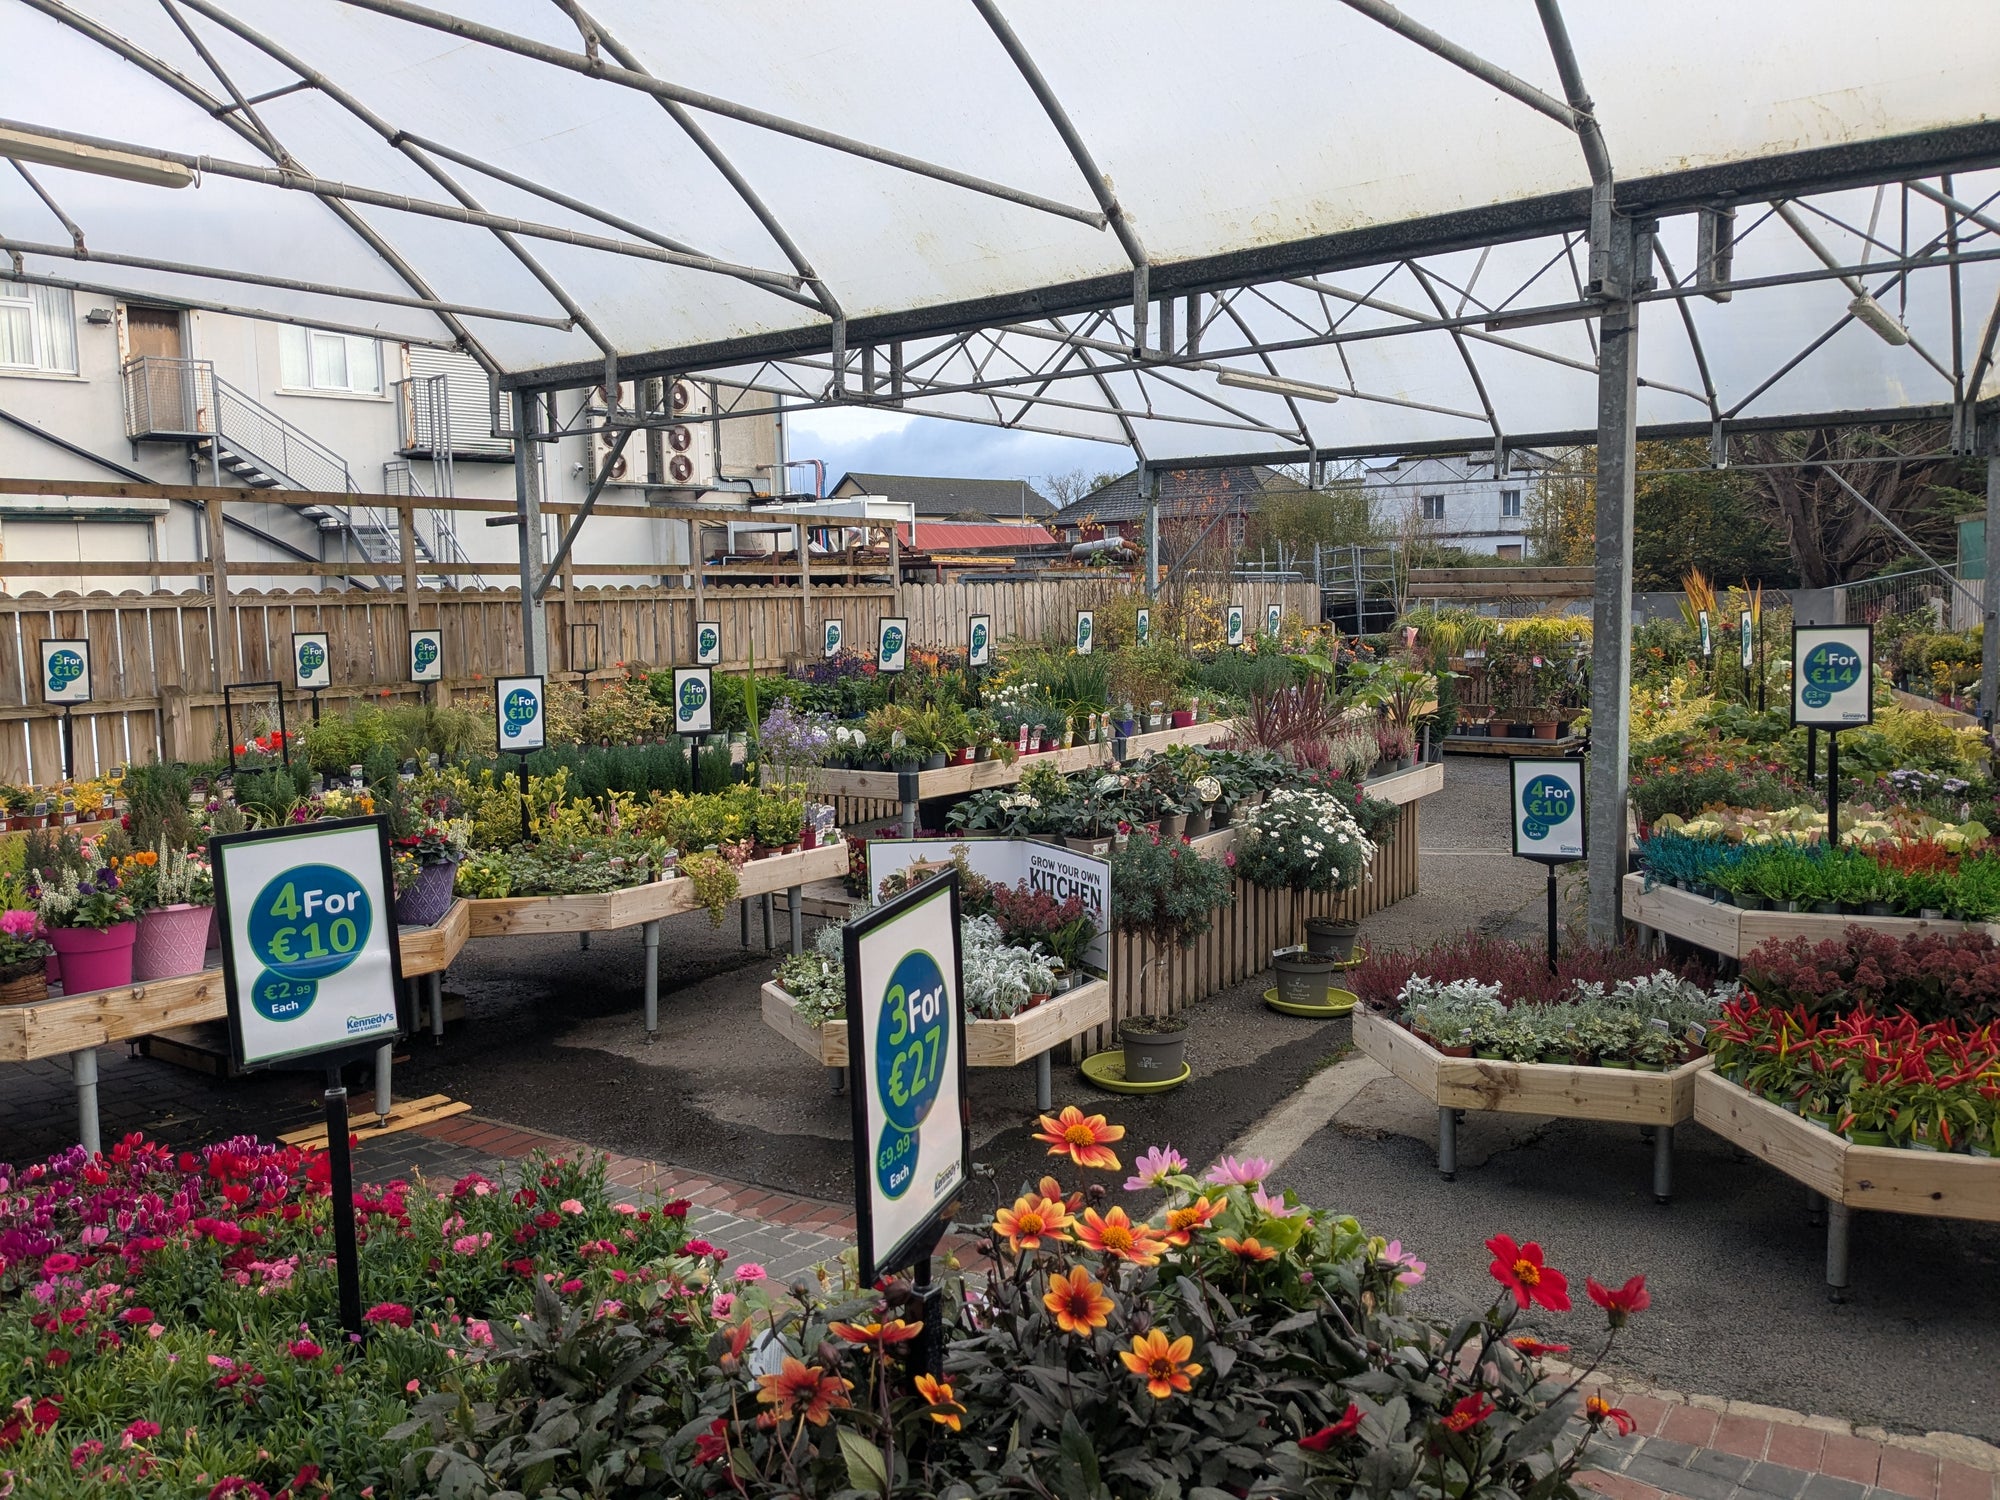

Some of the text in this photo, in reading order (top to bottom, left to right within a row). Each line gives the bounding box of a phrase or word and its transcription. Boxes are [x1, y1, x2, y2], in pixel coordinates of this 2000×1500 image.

[302, 655, 322, 665] €16
[417, 650, 435, 660] €16
[53, 665, 80, 676] €16
[1810, 667, 1853, 684] €14
[683, 693, 704, 706] €10
[508, 706, 534, 720] €10
[1529, 799, 1568, 817] €10
[1031, 855, 1101, 886] GROW YOUR OWN
[1029, 866, 1102, 910] KITCHEN
[267, 917, 357, 963] €10
[271, 1000, 300, 1014] Each
[346, 1012, 394, 1029] Kennedy's
[888, 1024, 941, 1107] €27
[879, 1133, 911, 1171] €9.99
[889, 1164, 910, 1190] Each
